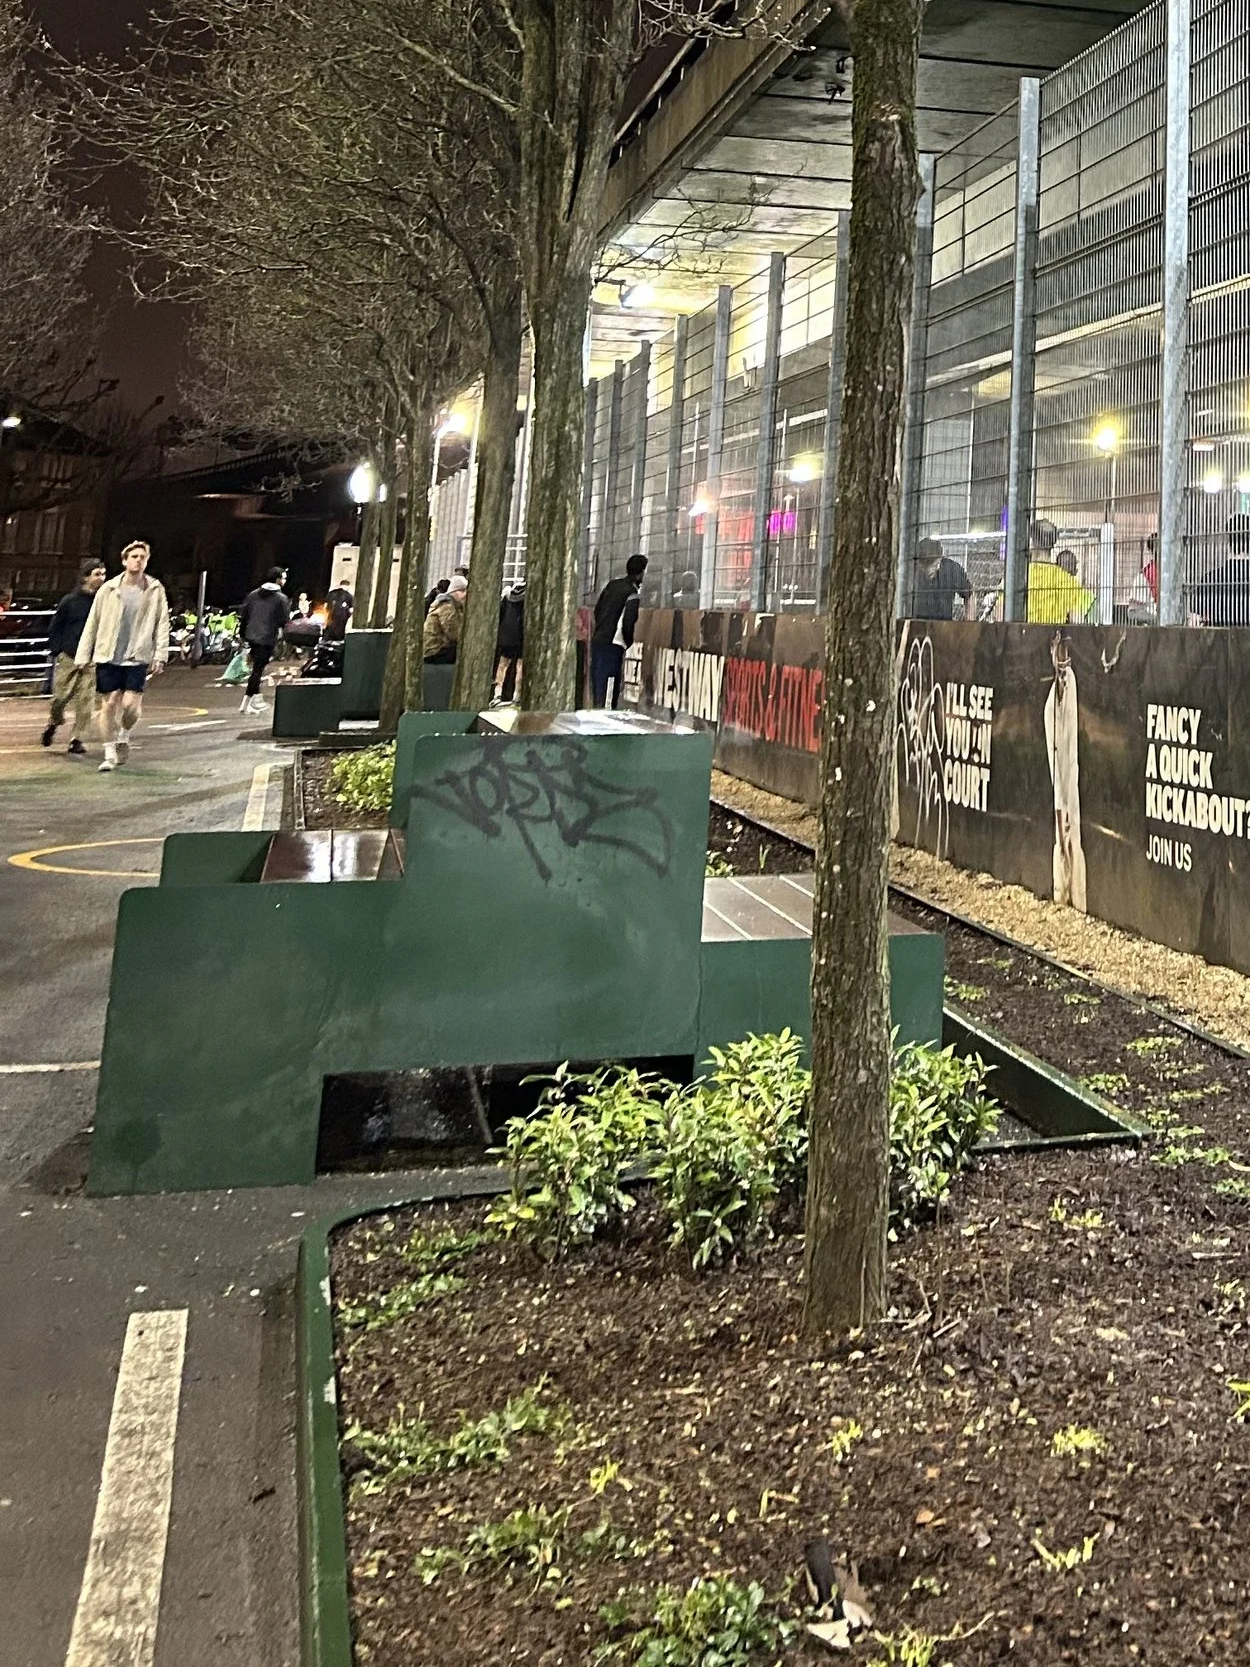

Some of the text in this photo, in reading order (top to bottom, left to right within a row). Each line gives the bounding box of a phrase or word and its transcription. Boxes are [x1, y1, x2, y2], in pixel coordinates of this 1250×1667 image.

[946, 681, 994, 722] I'LL SEE
[945, 716, 971, 761] YOU
[1146, 703, 1201, 745] FANCY
[943, 759, 991, 812] COURT
[1145, 743, 1213, 789] A QUICK
[1145, 834, 1192, 872] JOIN US
